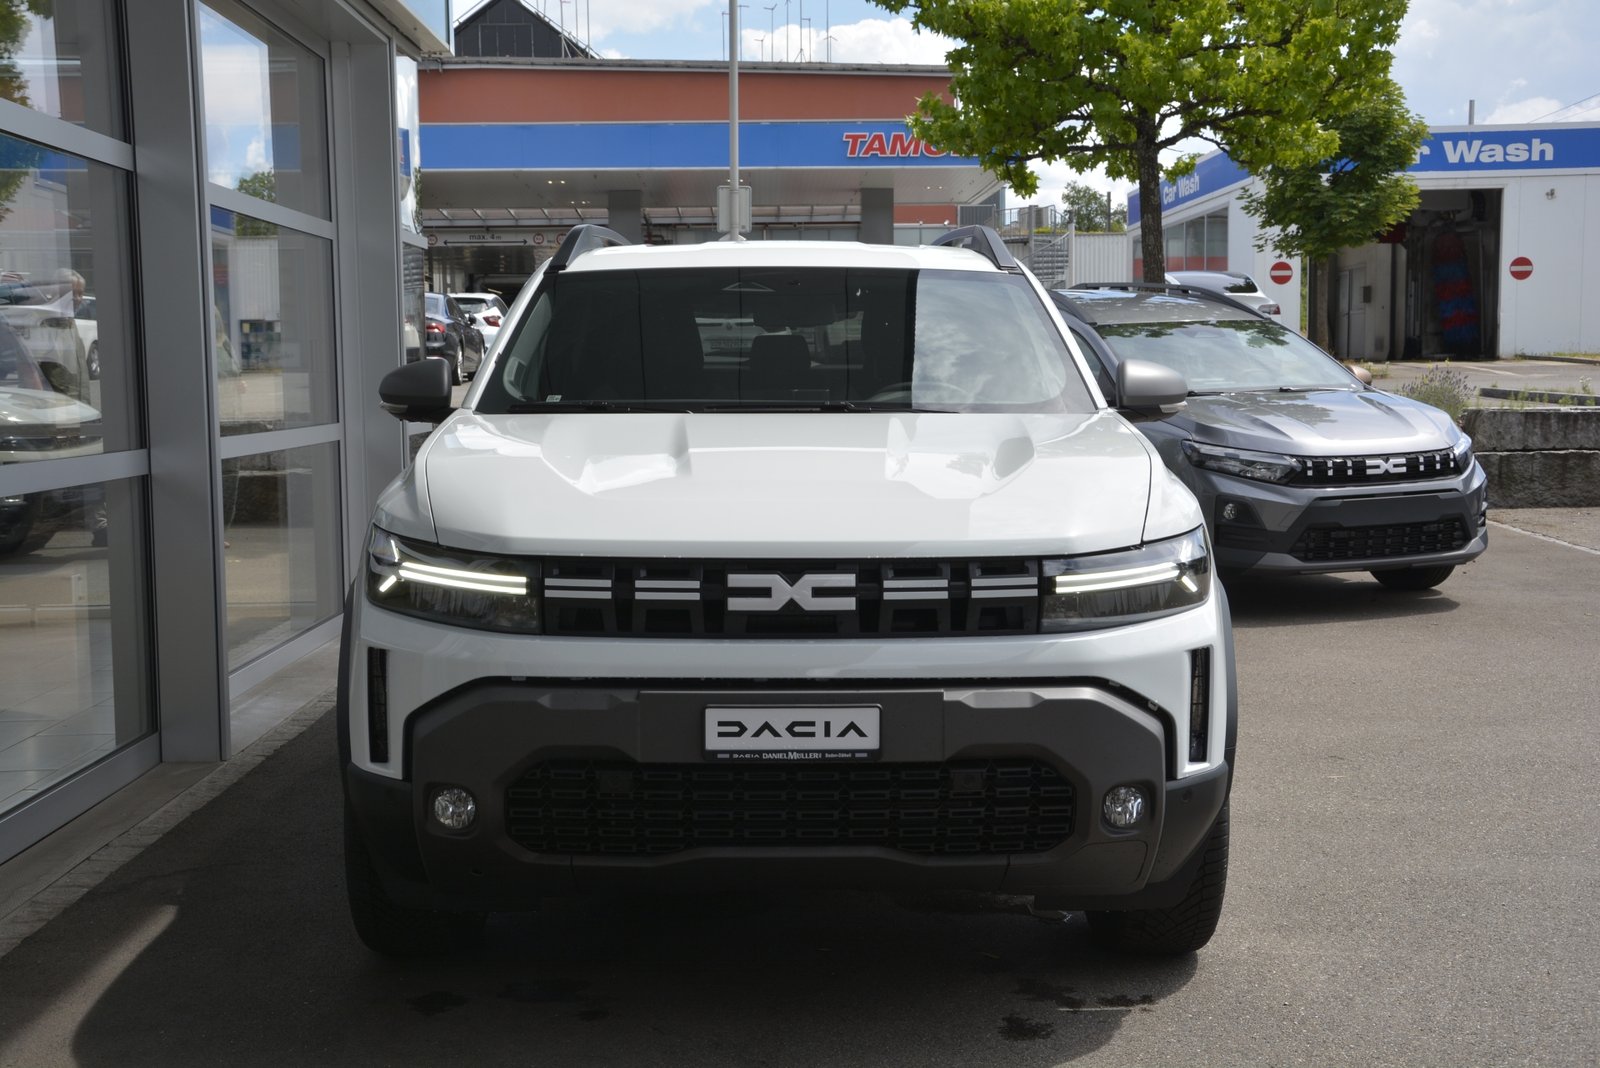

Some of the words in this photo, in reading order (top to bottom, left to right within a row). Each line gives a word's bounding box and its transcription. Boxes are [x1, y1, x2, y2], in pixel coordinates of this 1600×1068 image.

[1442, 138, 1554, 163] Wash
[1163, 183, 1176, 205] Car
[1178, 172, 1200, 198] Wash
[717, 720, 869, 738] DACIA
